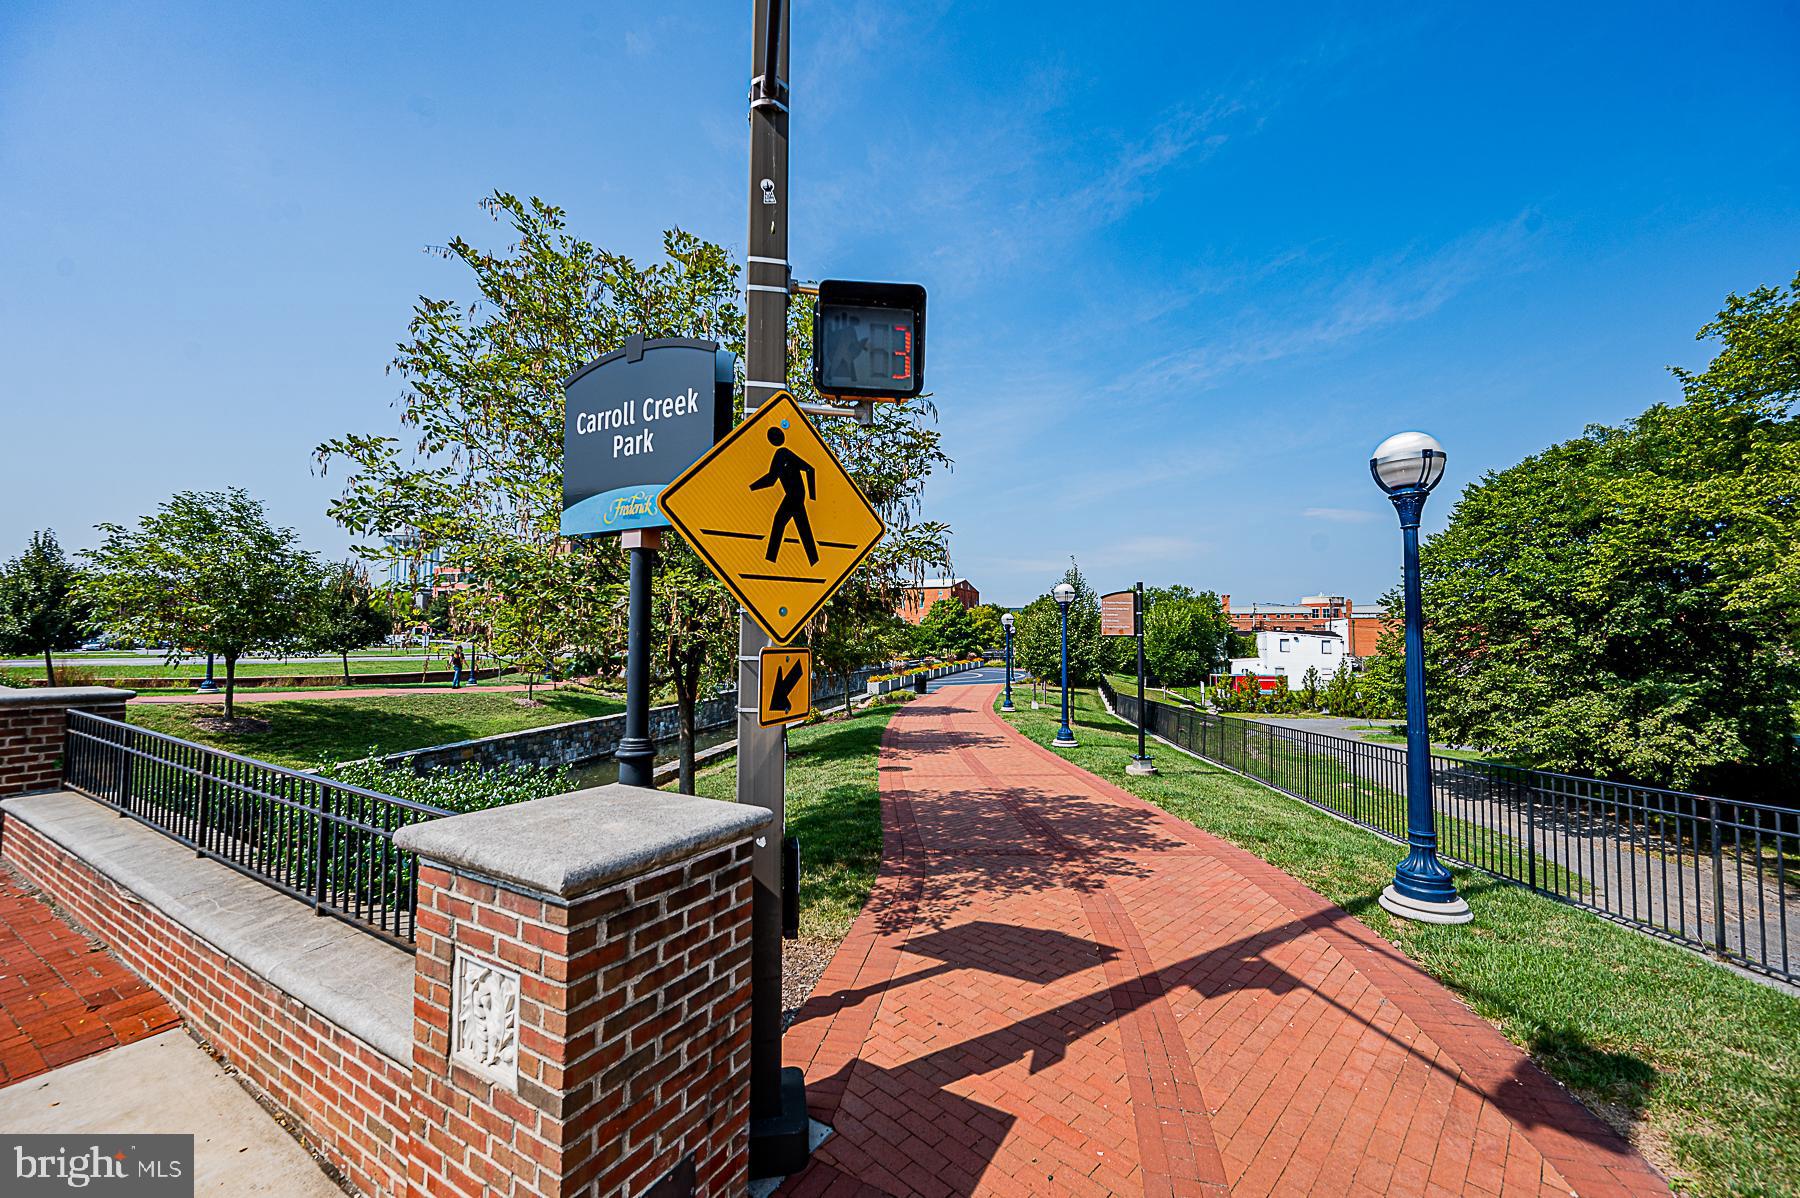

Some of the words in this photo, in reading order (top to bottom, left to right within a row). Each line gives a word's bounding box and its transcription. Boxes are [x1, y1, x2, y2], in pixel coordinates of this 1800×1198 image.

[892, 325, 912, 379] 3
[576, 400, 635, 435] Carroll
[642, 387, 699, 422] Creek
[613, 428, 654, 459] Park
